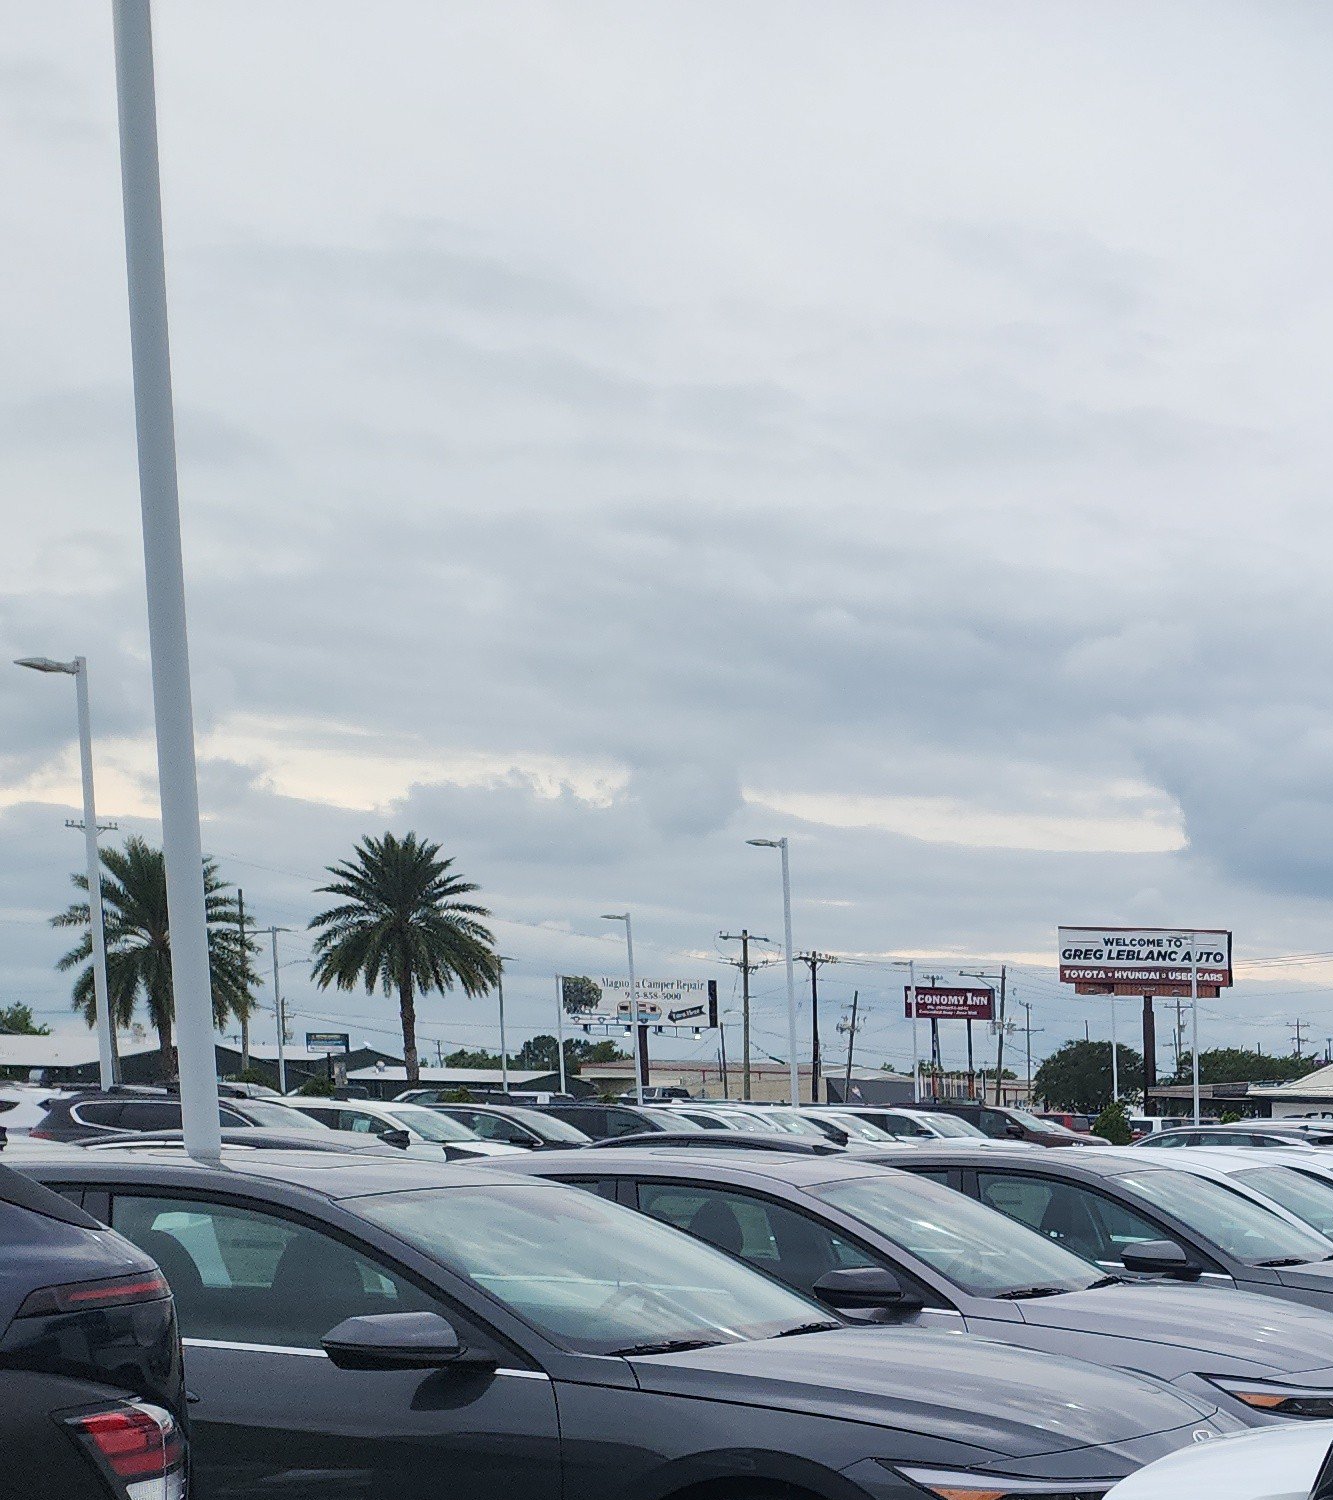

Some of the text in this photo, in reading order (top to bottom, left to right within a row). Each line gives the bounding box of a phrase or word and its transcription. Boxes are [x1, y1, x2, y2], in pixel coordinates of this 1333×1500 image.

[1103, 937, 1182, 948] WELCOME TO
[1062, 949, 1103, 960] GREG
[1107, 949, 1178, 962] LEBLANC
[1064, 969, 1105, 979] TOYOTA
[1114, 970, 1160, 979] HYUNDAI
[1196, 972, 1223, 982] CARS
[601, 978, 704, 993] Magnoa Camper Repair
[624, 992, 681, 1000] 95-858-5000
